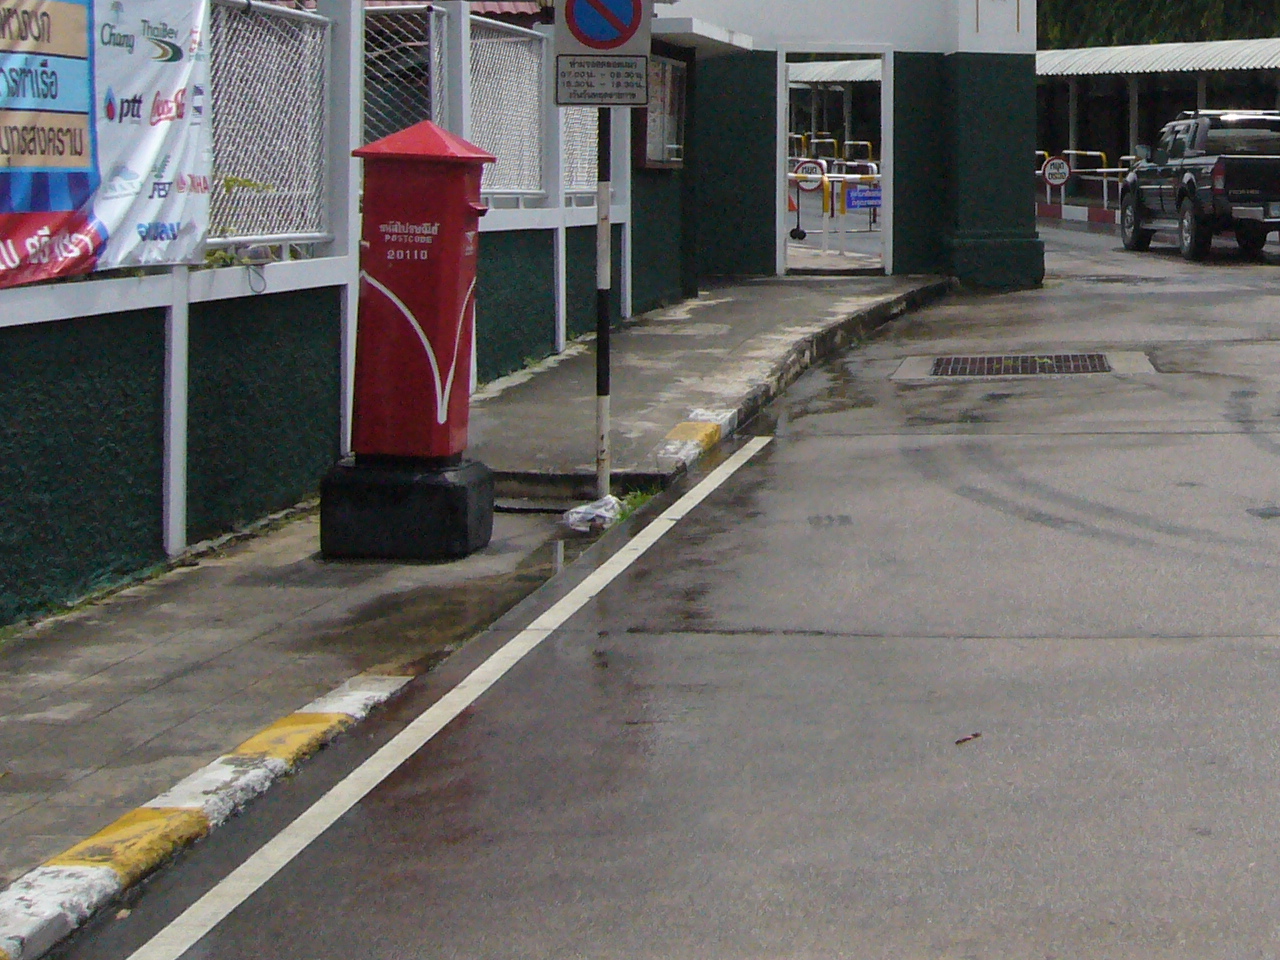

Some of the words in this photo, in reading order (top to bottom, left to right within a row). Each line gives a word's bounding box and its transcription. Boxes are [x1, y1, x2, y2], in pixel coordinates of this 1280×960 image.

[100, 22, 136, 54] Chang
[0, 56, 58, 100] ารท่าเรือ
[386, 249, 429, 260] 20110
